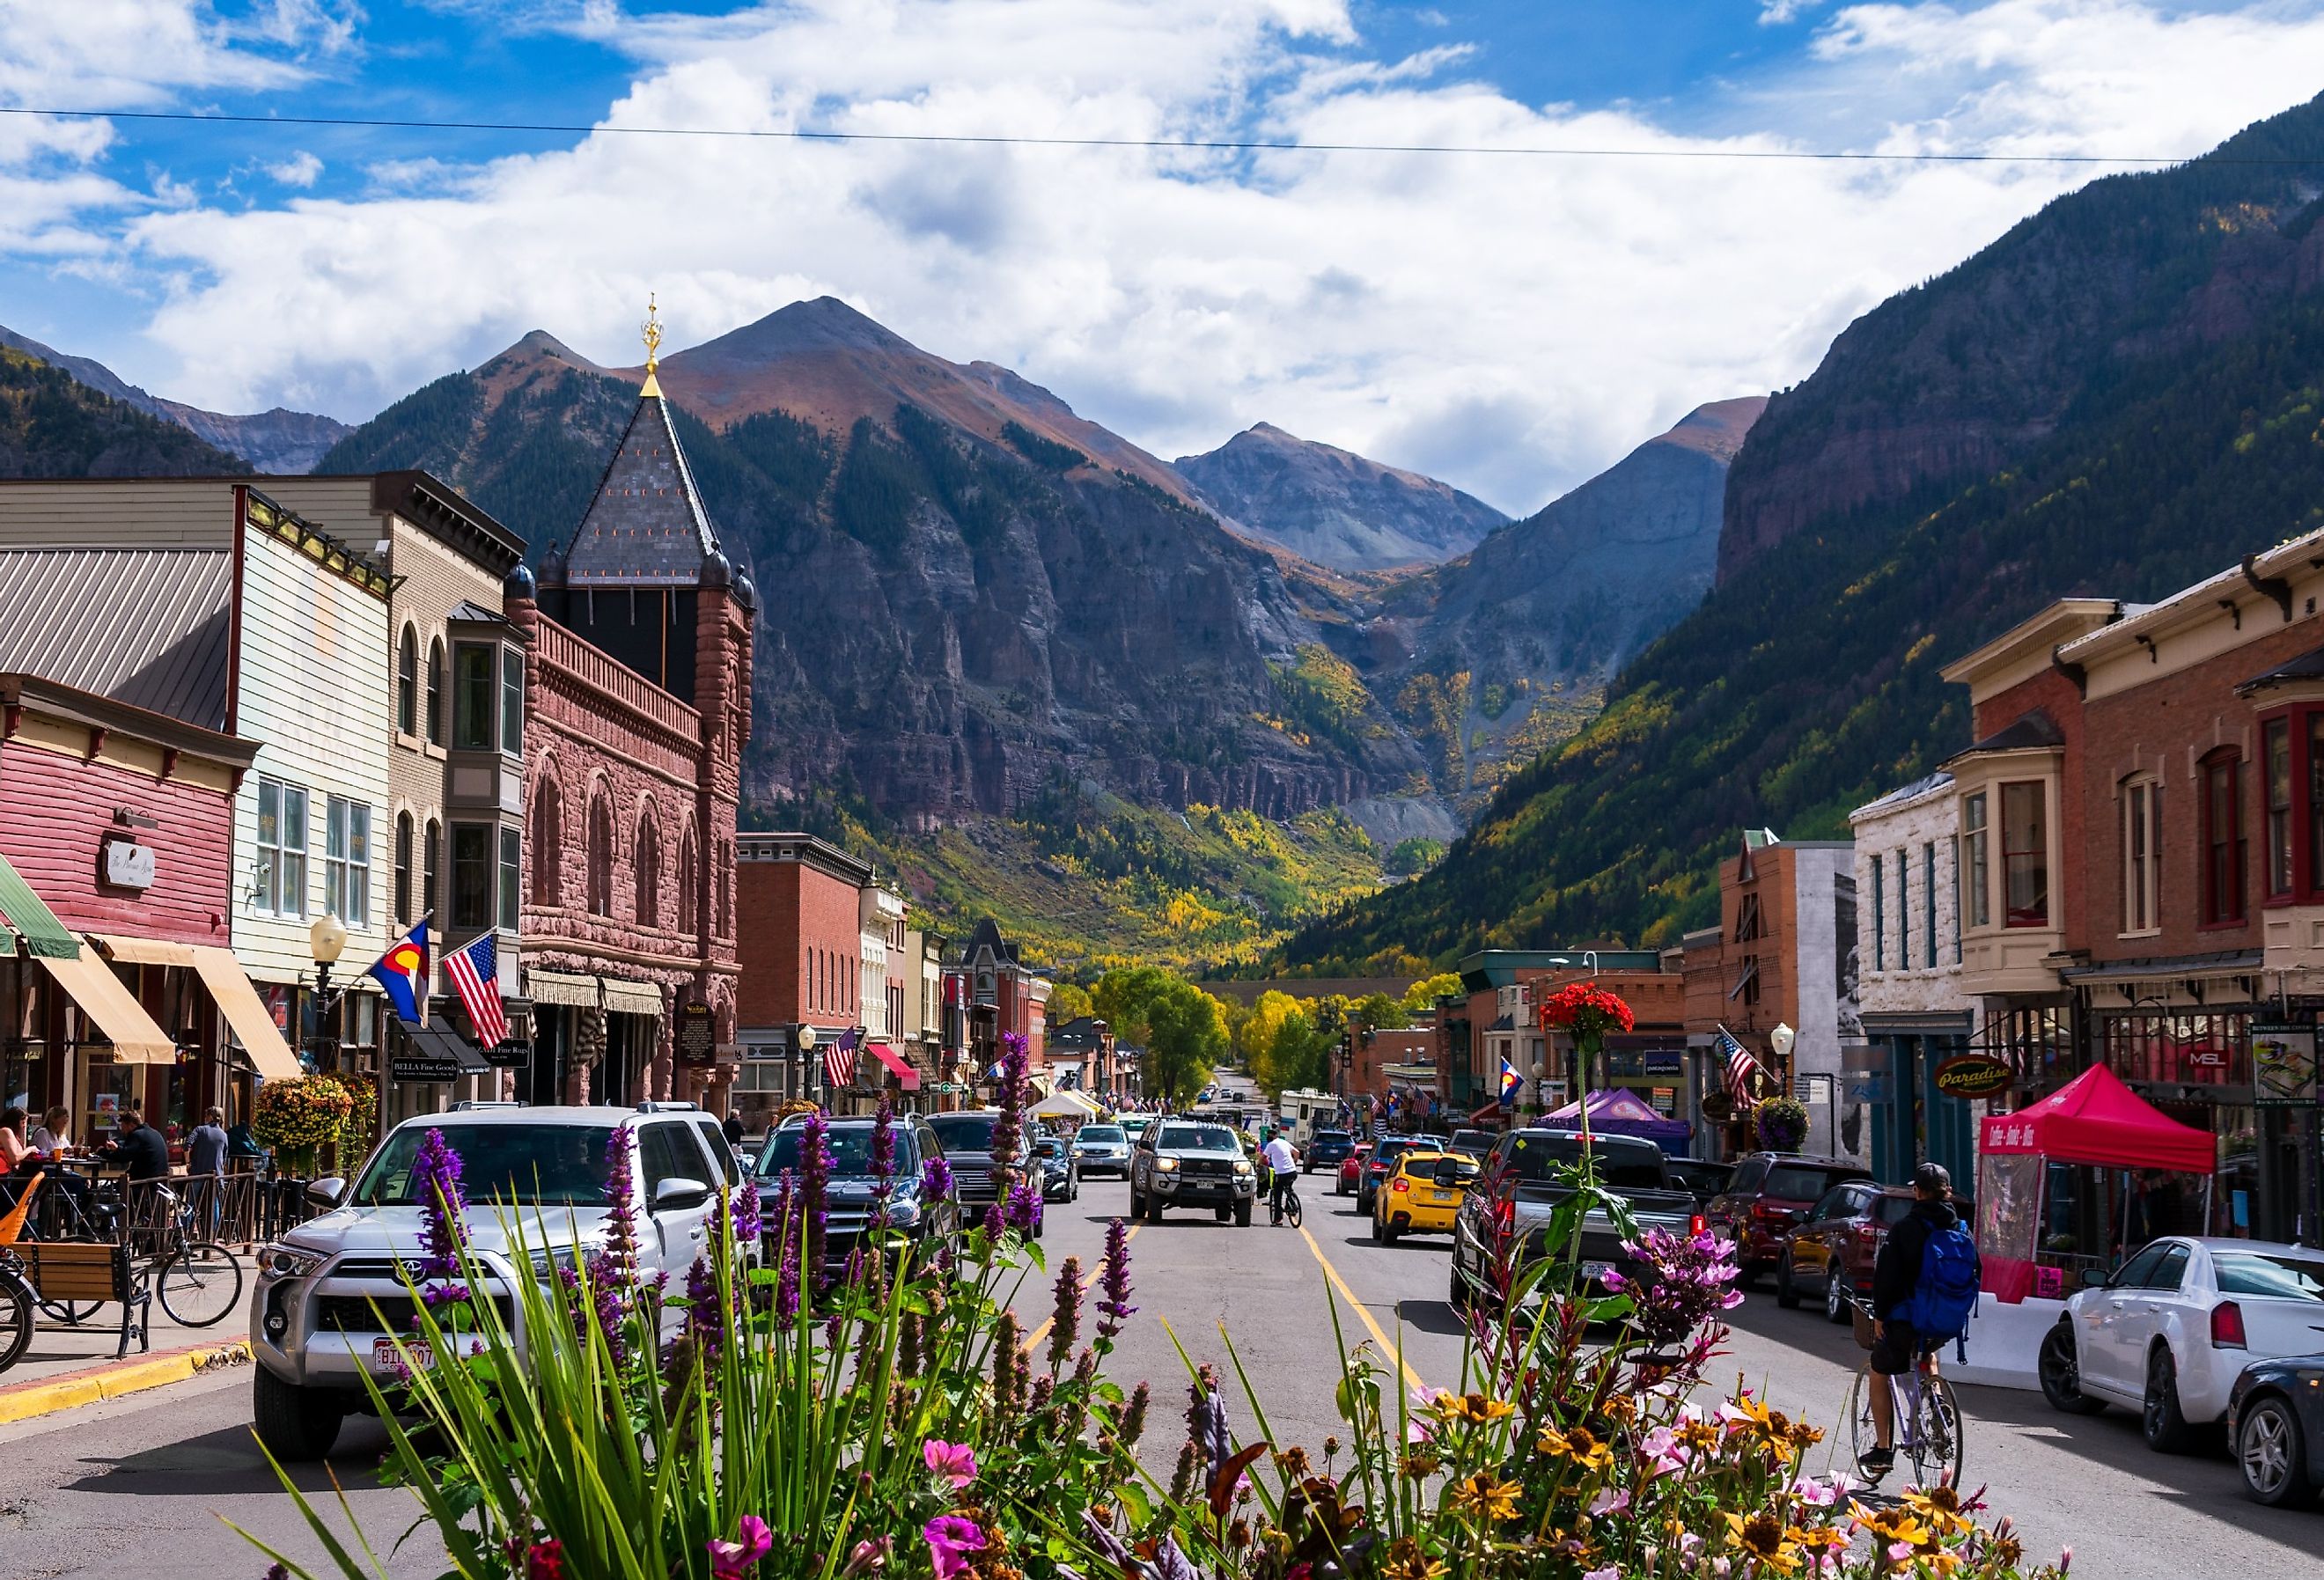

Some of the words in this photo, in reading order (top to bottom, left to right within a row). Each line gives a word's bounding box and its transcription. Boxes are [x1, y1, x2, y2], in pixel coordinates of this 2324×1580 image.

[2190, 1054, 2226, 1065] MSL
[436, 1063, 457, 1072] Goods
[1938, 1066, 2009, 1088] Paradise
